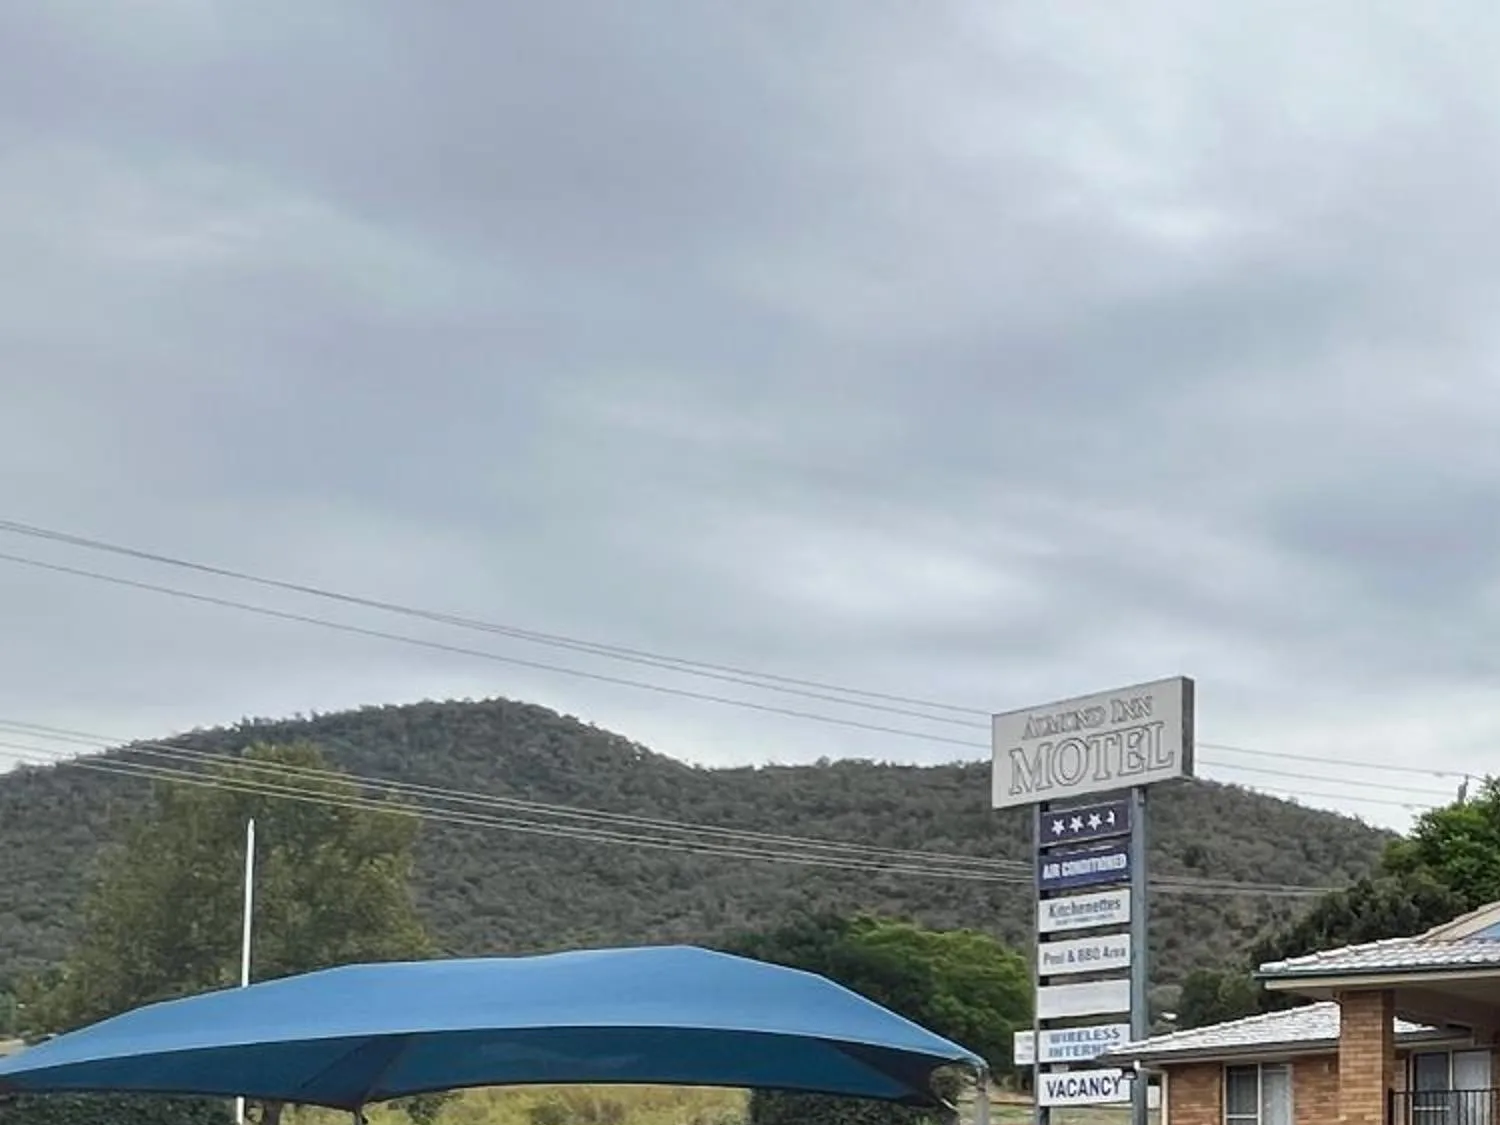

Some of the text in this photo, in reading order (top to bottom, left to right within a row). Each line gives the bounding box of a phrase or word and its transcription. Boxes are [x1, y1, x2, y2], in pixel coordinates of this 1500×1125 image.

[1008, 721, 1175, 796] MOTEL
[1043, 863, 1060, 879] AIR
[1068, 949, 1075, 963] &
[1103, 945, 1127, 959] Area
[1050, 1027, 1121, 1044] WIRELESS
[1046, 1075, 1123, 1099] VACANCY
